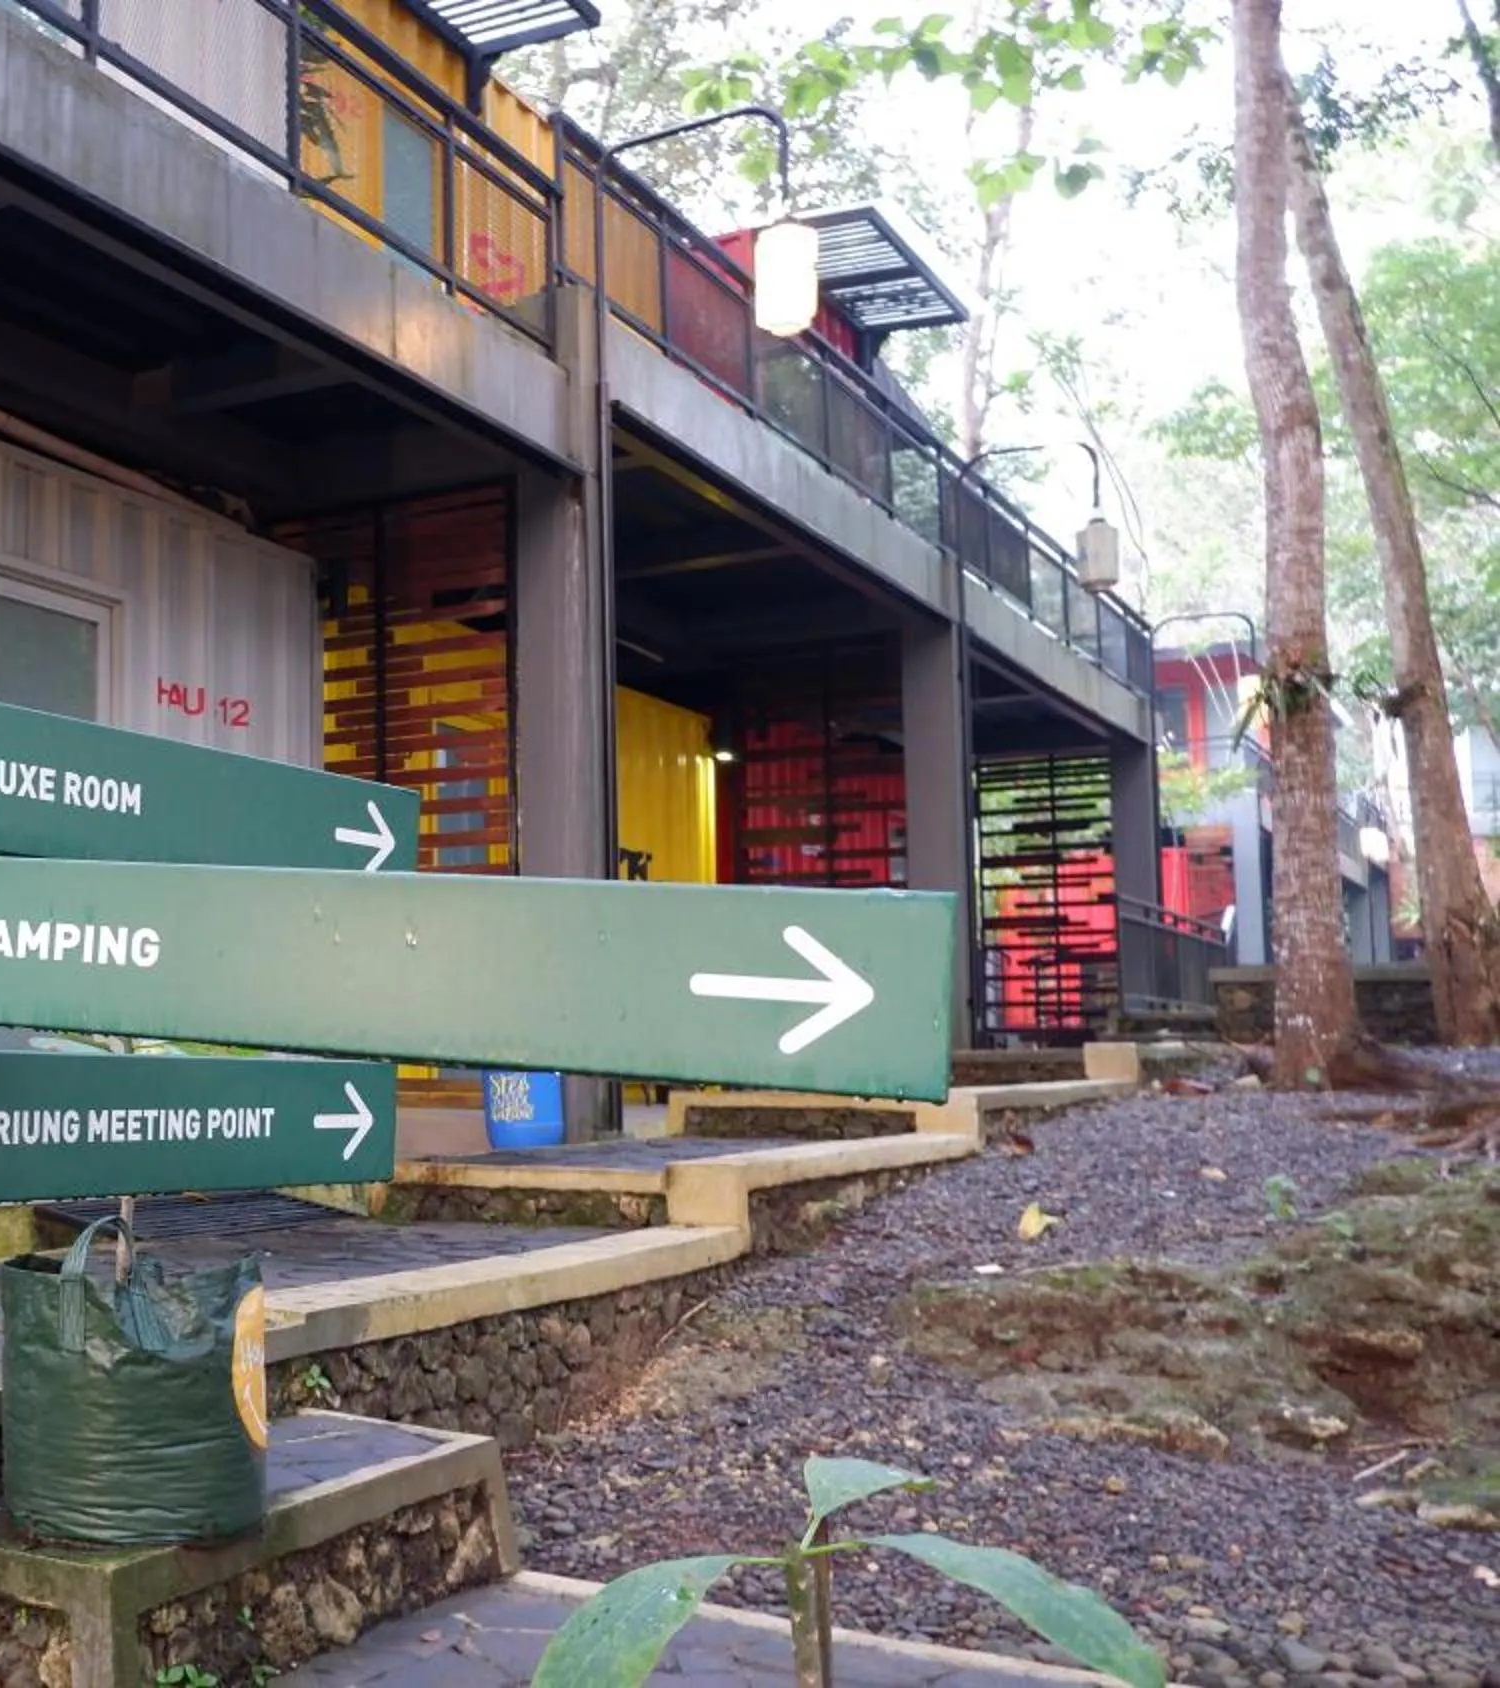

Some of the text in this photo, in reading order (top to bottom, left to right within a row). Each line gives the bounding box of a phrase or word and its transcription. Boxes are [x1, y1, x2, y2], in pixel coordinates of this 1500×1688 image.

[157, 676, 250, 727] HAU 12
[62, 770, 142, 816] ROOM
[86, 1107, 201, 1144] MEETING
[206, 1106, 276, 1140] POINT
